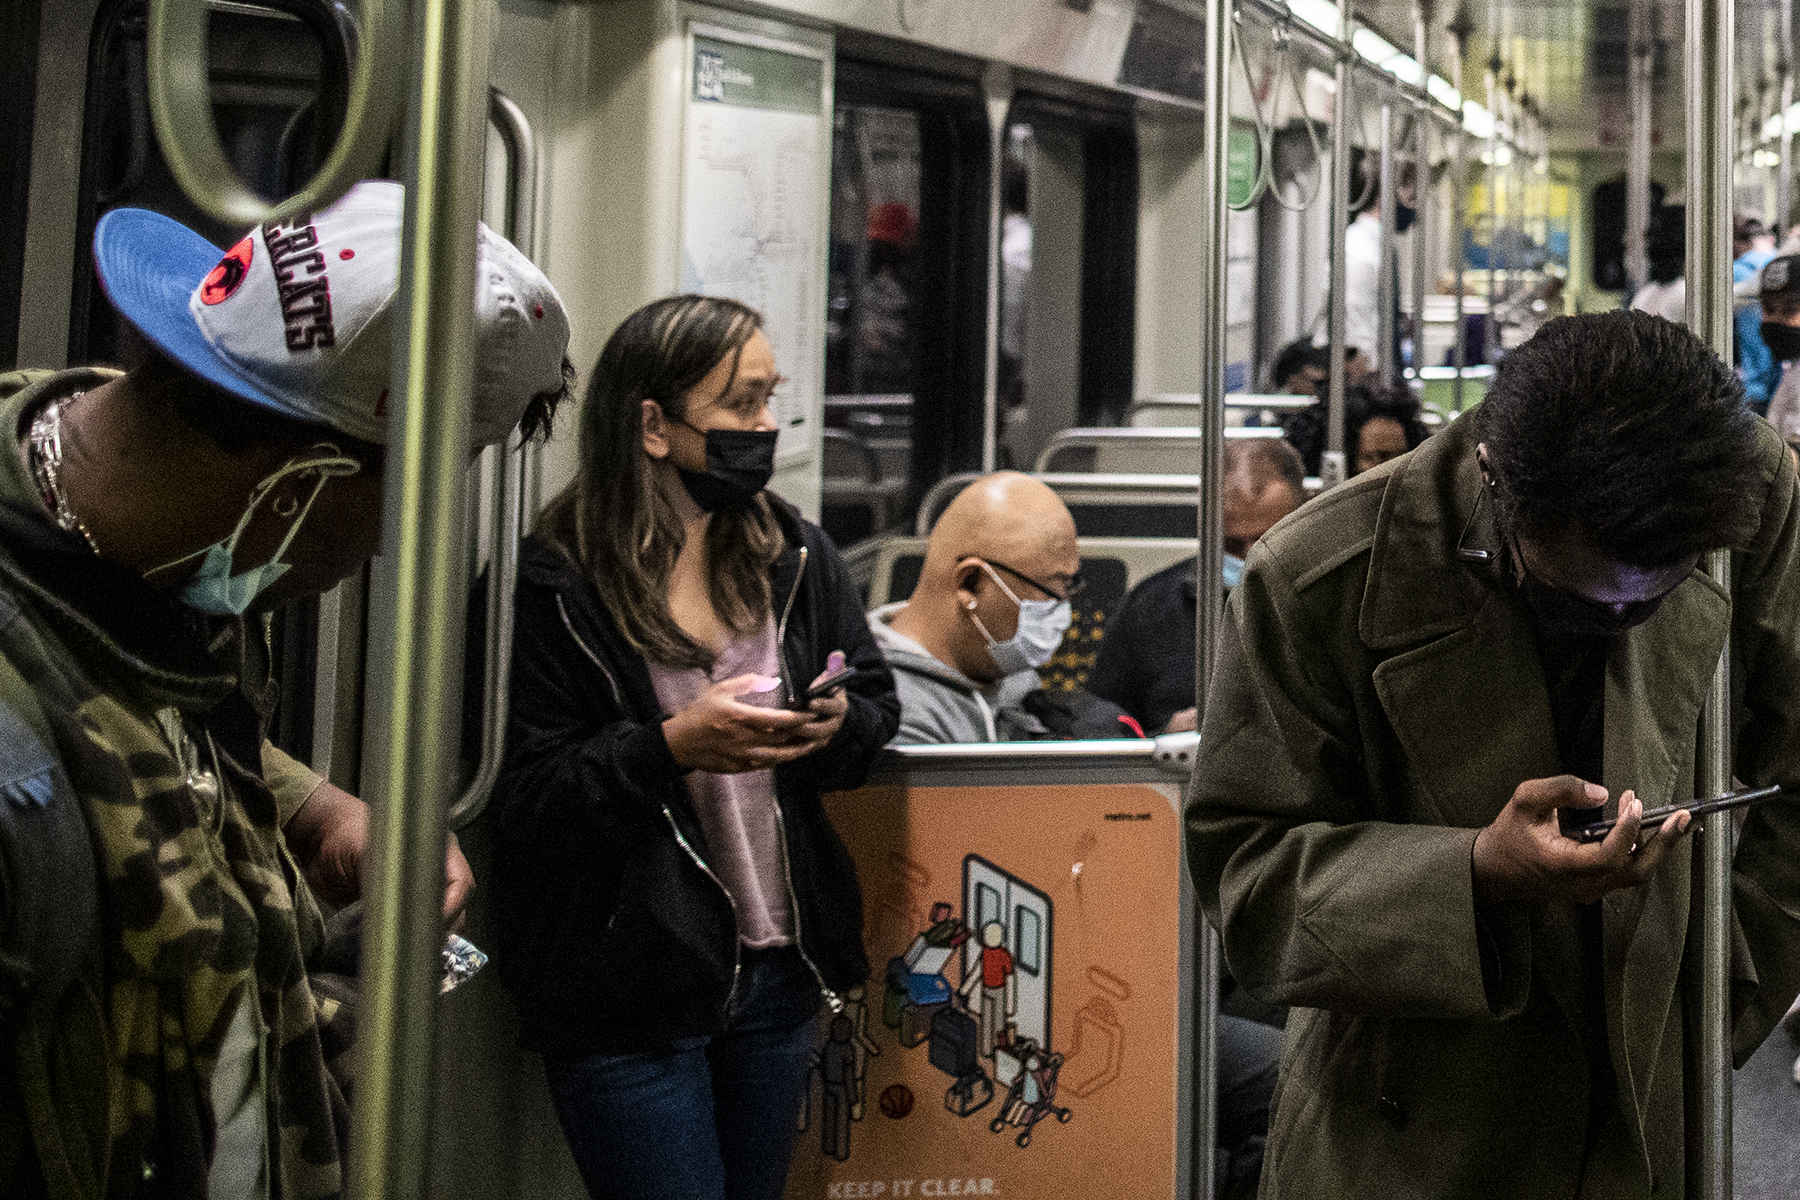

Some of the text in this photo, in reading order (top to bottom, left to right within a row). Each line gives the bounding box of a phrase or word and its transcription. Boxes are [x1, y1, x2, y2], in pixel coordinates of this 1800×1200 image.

[827, 1176, 1002, 1200] KEEP IT CLEAR.
